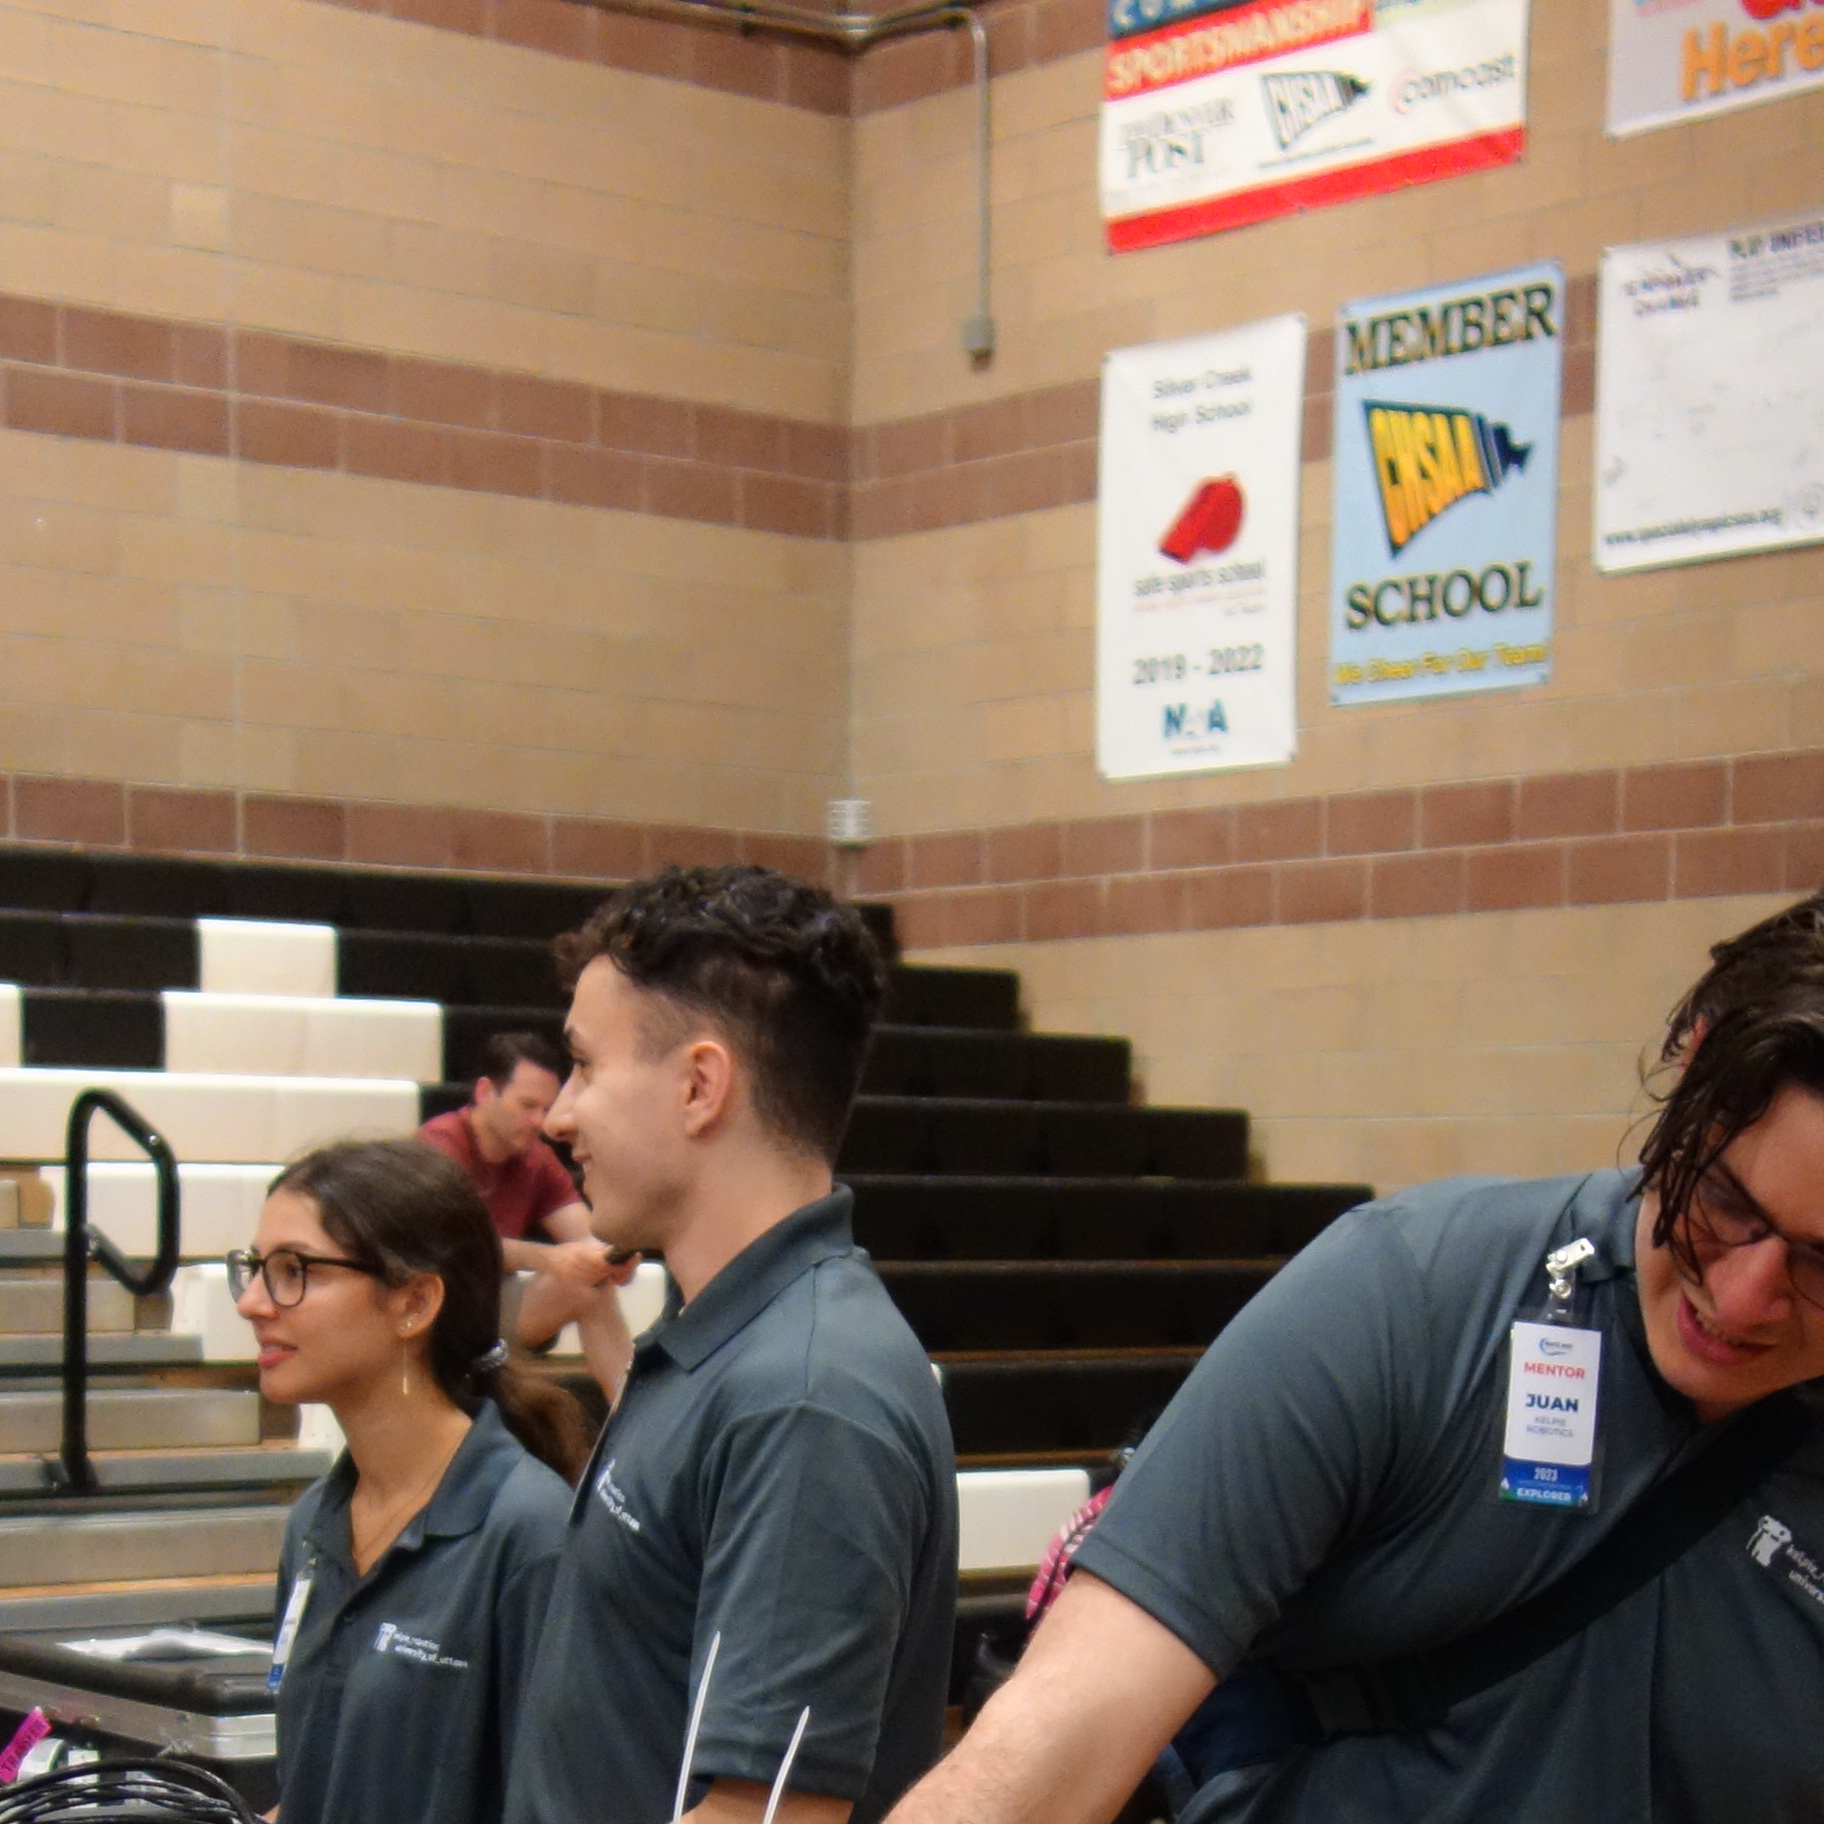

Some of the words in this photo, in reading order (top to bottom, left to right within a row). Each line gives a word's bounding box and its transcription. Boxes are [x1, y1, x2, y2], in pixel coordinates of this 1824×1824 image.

[1127, 128, 1207, 178] POST
[1345, 280, 1558, 376] MEMBER
[1345, 560, 1547, 629] SCHOOL
[1134, 653, 1187, 684] 2019
[1208, 643, 1264, 675] 2022
[1523, 1362, 1586, 1379] MENTOR
[1525, 1393, 1580, 1412] JUAN
[1516, 1487, 1572, 1501] EXPLORER
